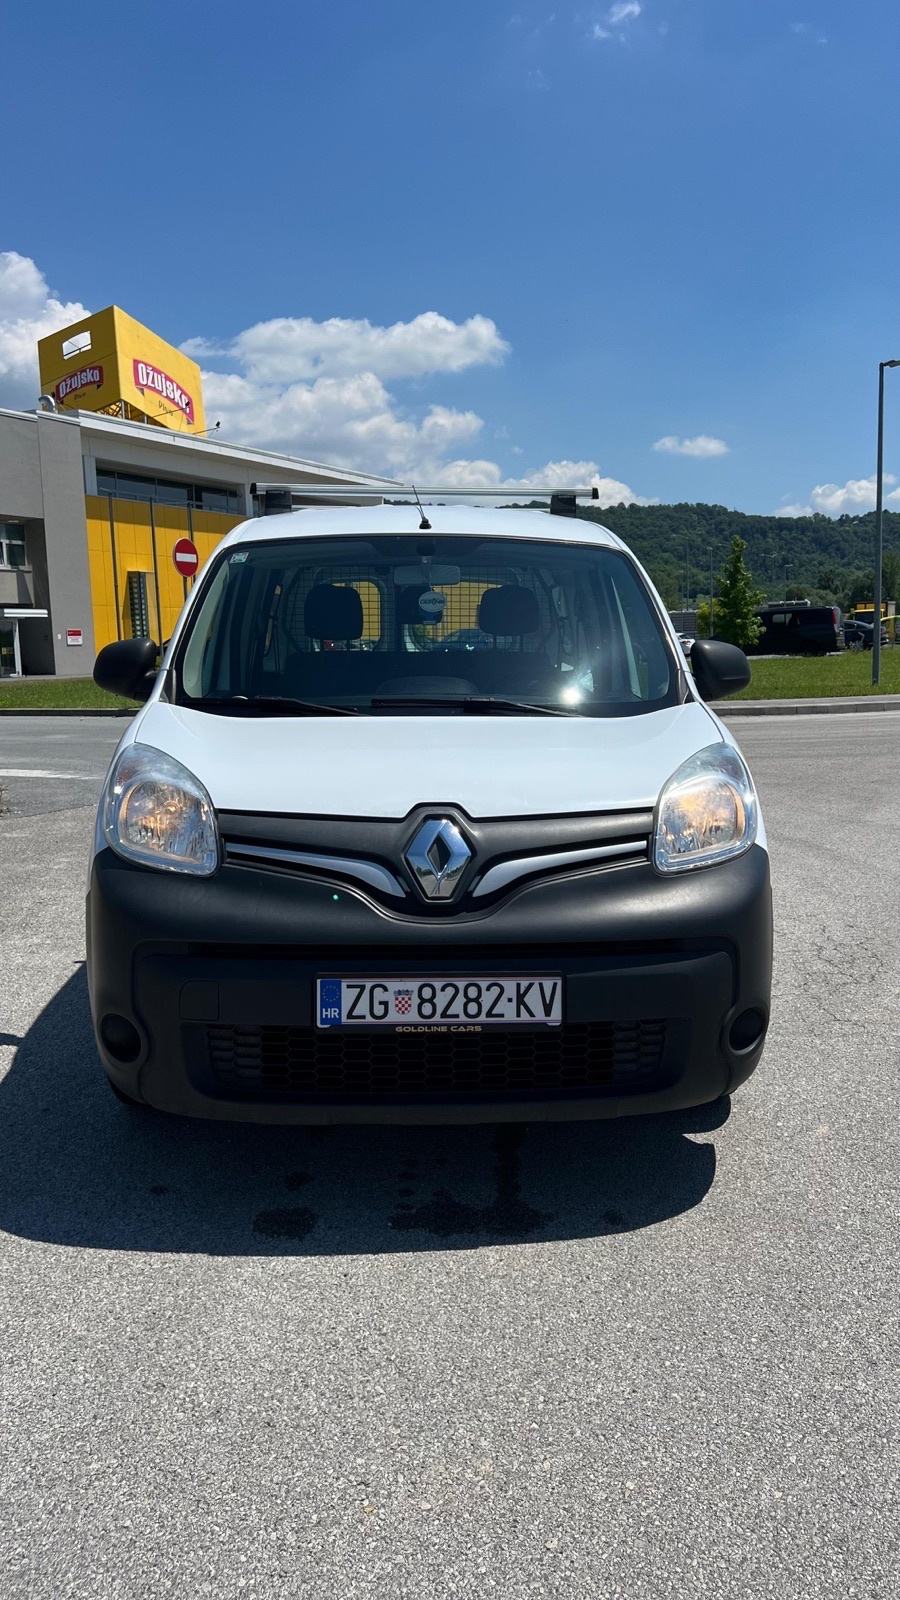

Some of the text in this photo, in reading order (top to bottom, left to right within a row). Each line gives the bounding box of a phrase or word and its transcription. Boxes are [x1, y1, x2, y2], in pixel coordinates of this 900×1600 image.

[59, 368, 100, 398] Ožujsko
[346, 983, 390, 1020] ZG
[322, 1007, 340, 1019] HR
[395, 1025, 482, 1033] GOLDLINE CARS
